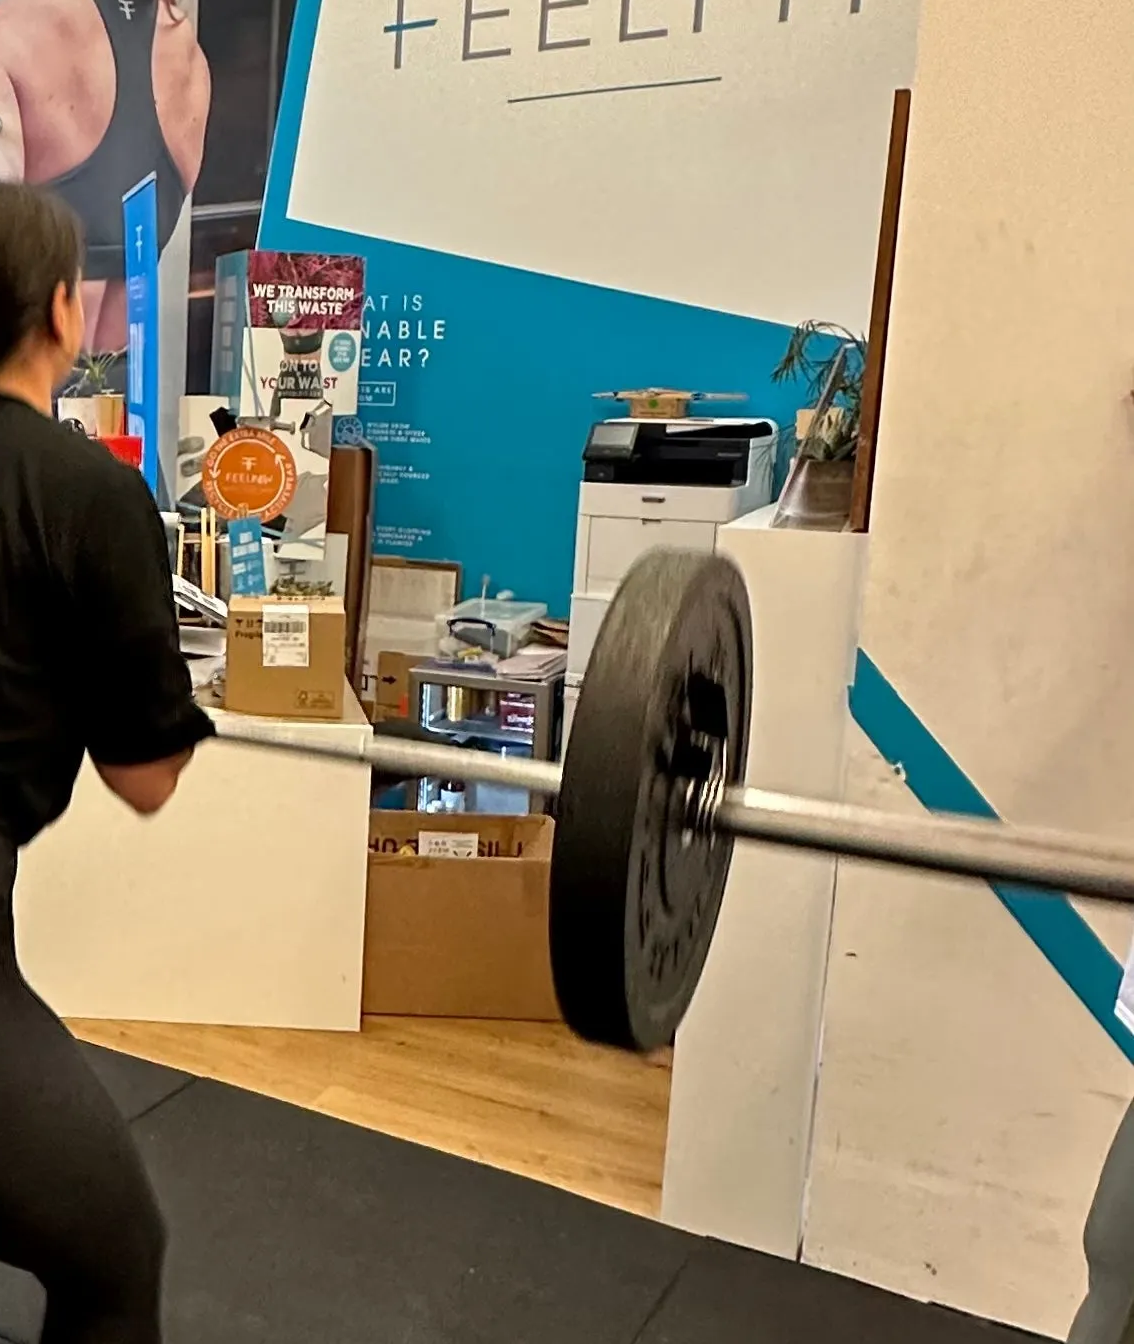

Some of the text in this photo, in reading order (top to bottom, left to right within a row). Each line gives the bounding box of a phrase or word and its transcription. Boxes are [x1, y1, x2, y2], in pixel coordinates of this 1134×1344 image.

[253, 283, 355, 301] WE TRANSFORM
[266, 299, 343, 315] THIS WASTE
[362, 294, 423, 312] AT IS
[280, 358, 319, 373] ON TO
[360, 348, 430, 368] EAR?
[298, 376, 338, 390] WAST
